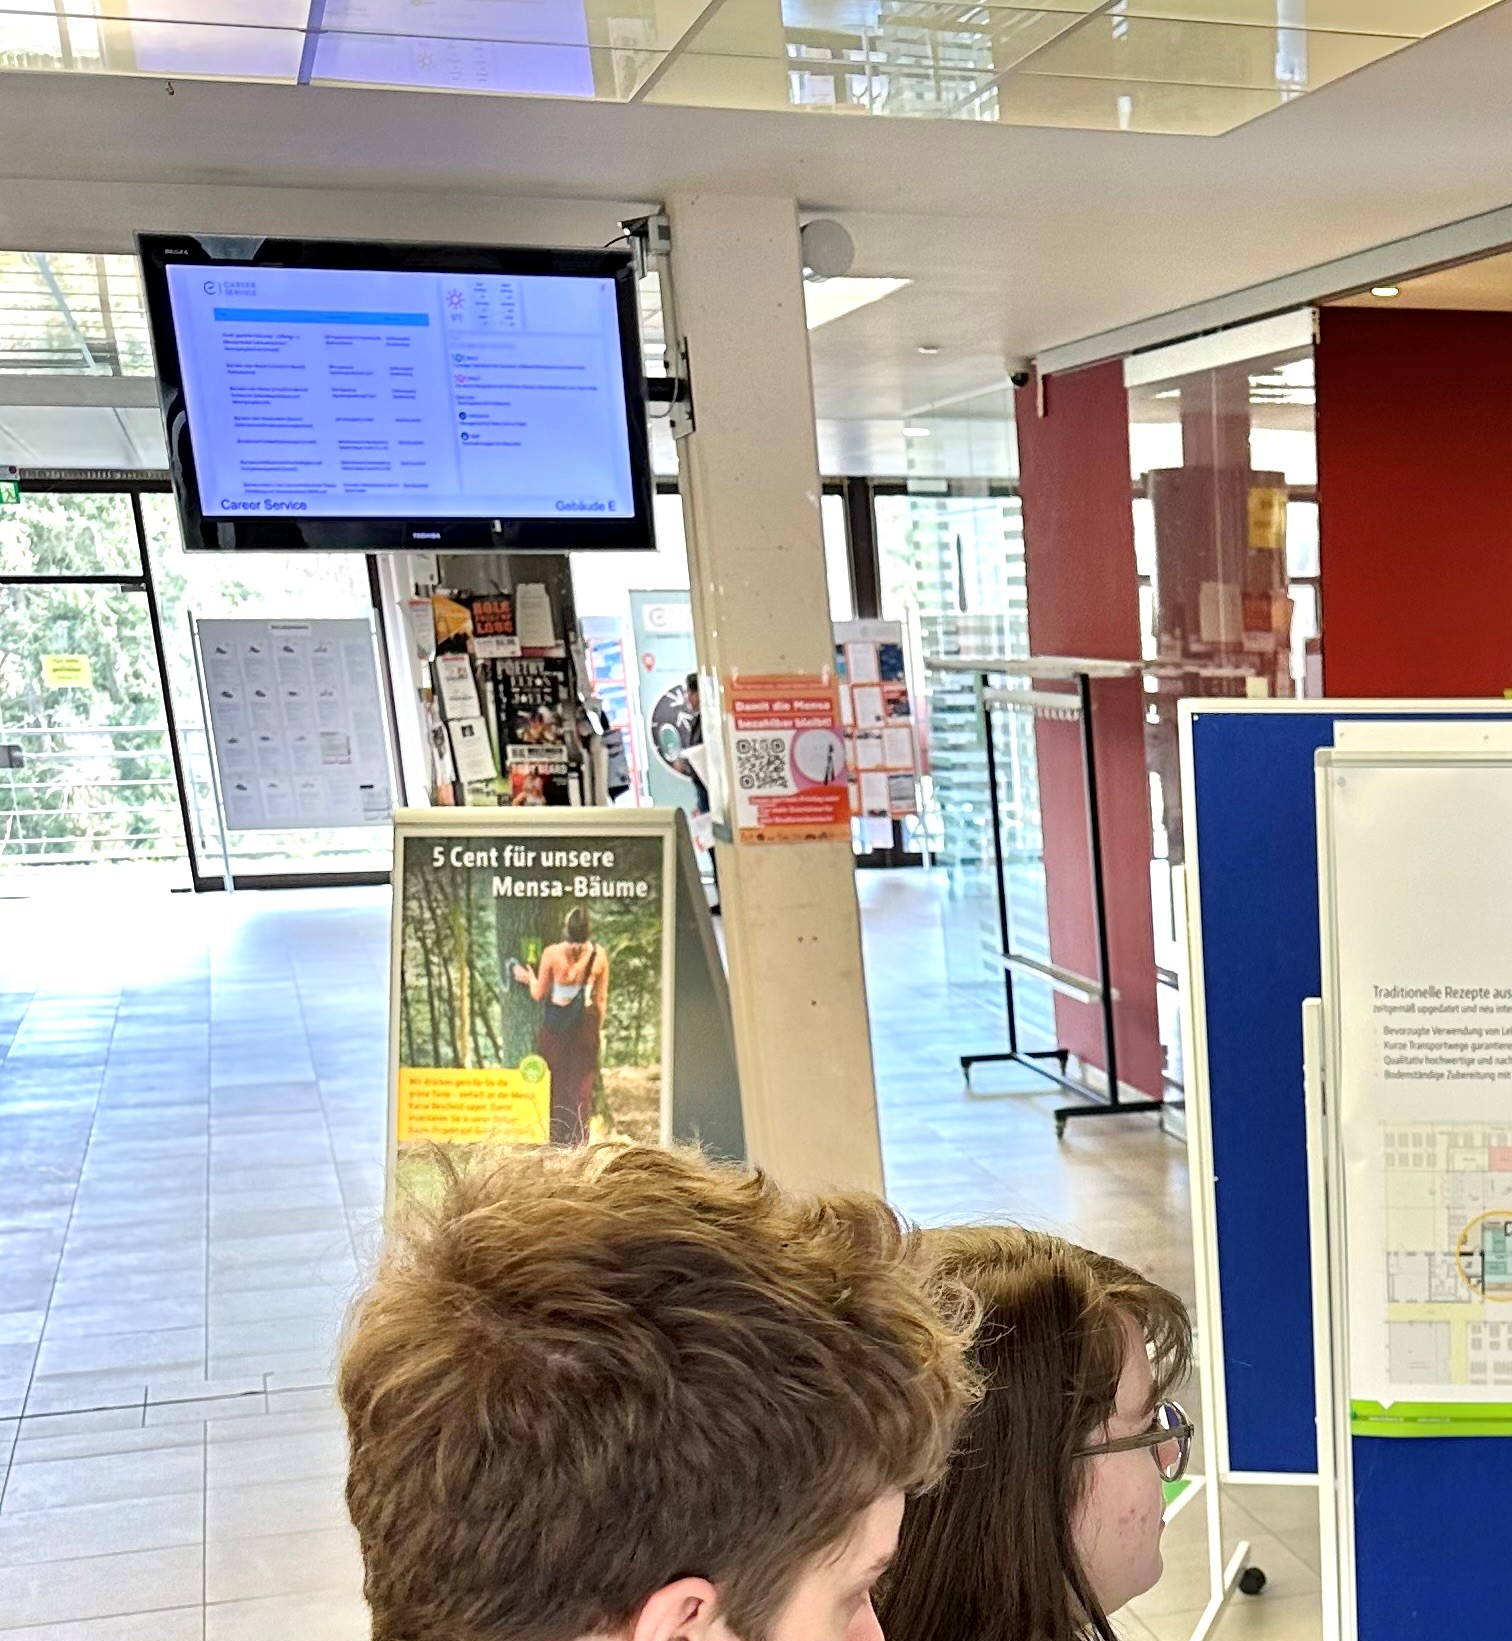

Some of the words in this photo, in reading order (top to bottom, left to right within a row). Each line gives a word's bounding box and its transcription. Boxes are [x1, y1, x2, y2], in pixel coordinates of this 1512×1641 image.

[221, 498, 261, 510] Career
[264, 498, 307, 510] Service
[608, 500, 616, 511] E
[433, 846, 445, 868] 5
[449, 846, 499, 868] Cent
[503, 845, 536, 868] für
[541, 849, 615, 868] unsere
[492, 875, 649, 899] Mensa-Bäume
[1372, 984, 1443, 1000] Traditionelle
[1444, 984, 1491, 1002] Rezepte
[1492, 987, 1512, 1000] aus
